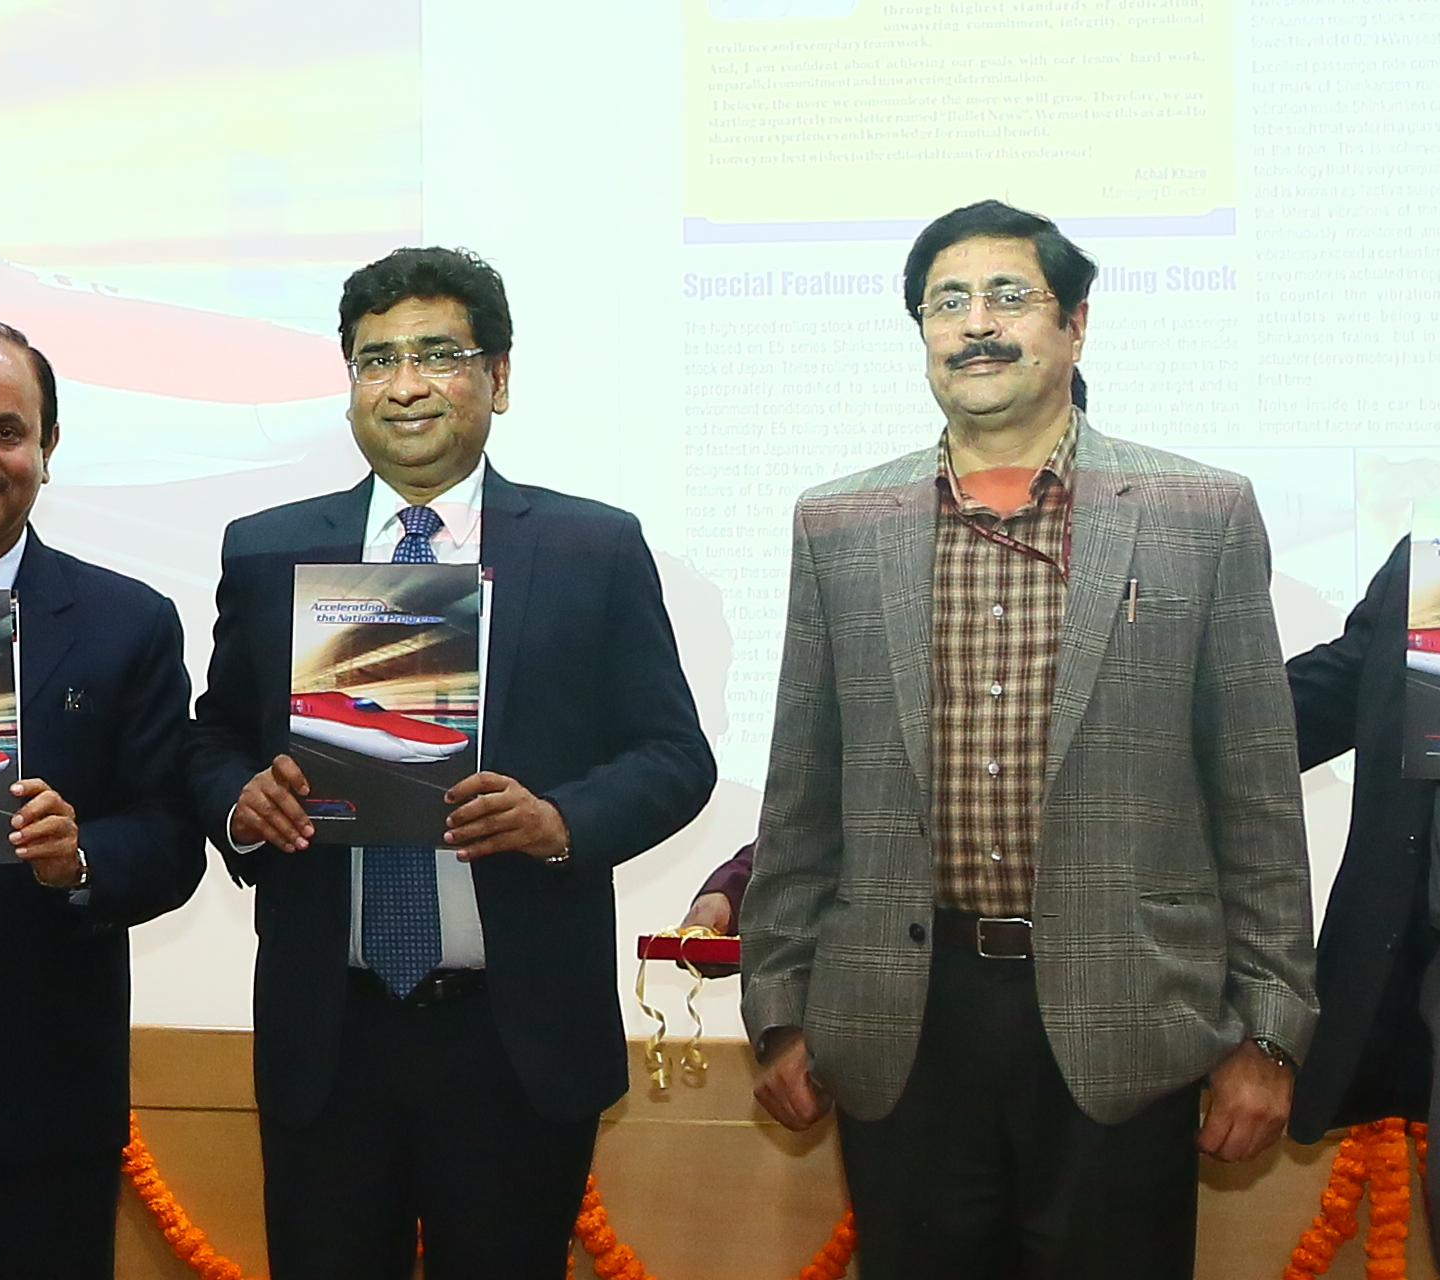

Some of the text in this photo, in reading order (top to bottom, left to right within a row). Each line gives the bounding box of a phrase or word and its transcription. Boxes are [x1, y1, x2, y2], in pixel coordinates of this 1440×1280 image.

[682, 270, 773, 301] Special
[780, 270, 884, 297] Features
[1165, 264, 1238, 292] Stock
[310, 602, 383, 612] Accelerating
[316, 613, 336, 622] the
